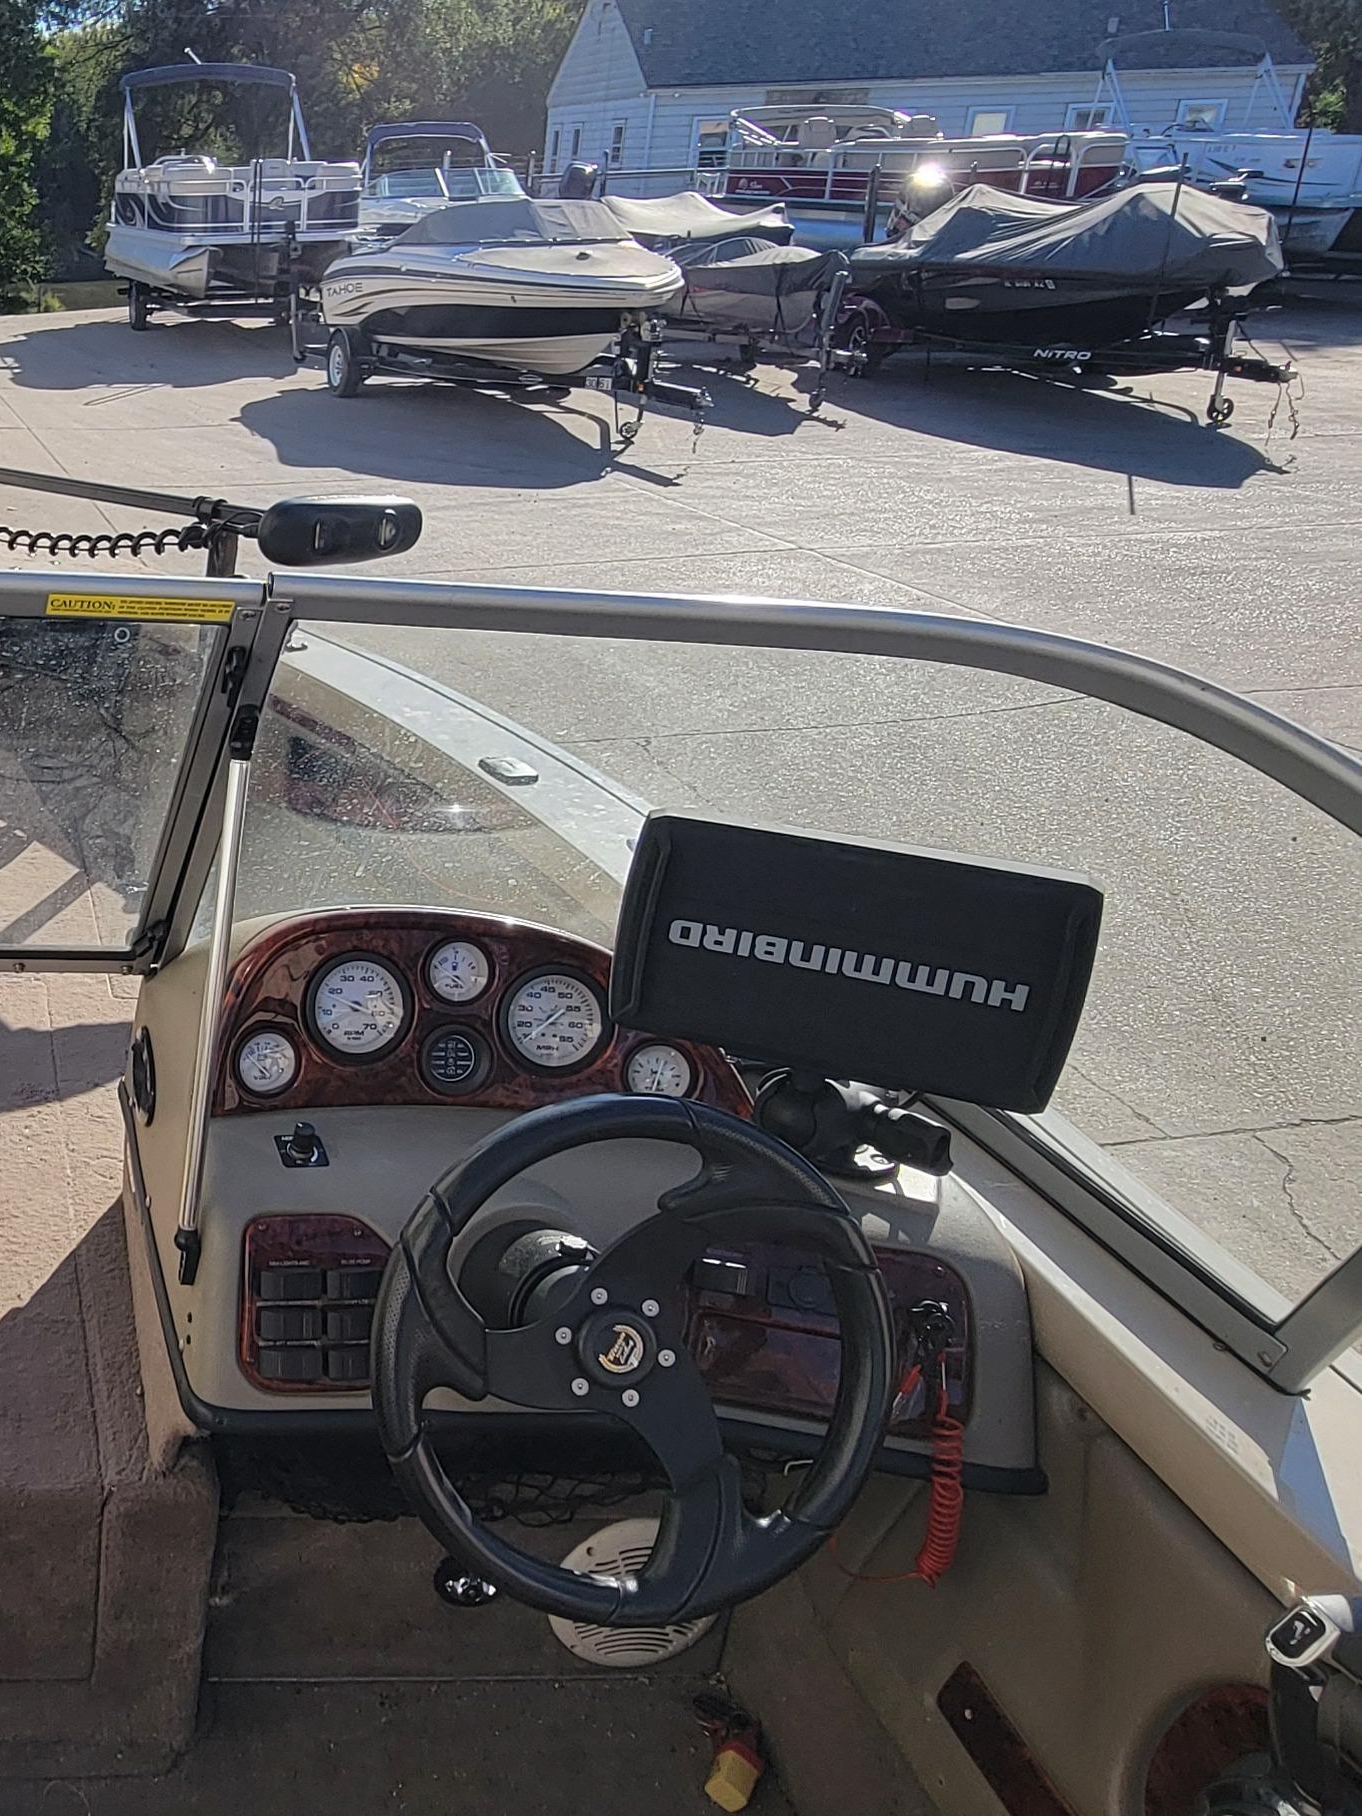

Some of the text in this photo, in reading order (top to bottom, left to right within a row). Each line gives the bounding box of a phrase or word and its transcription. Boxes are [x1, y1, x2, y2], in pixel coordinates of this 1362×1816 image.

[326, 282, 364, 297] TAHOE
[1033, 348, 1092, 360] NITRO
[49, 598, 116, 611] CAUTION:
[669, 918, 1030, 1013] HUMMINBIRD
[328, 987, 343, 995] 20
[568, 1021, 583, 1029] 60
